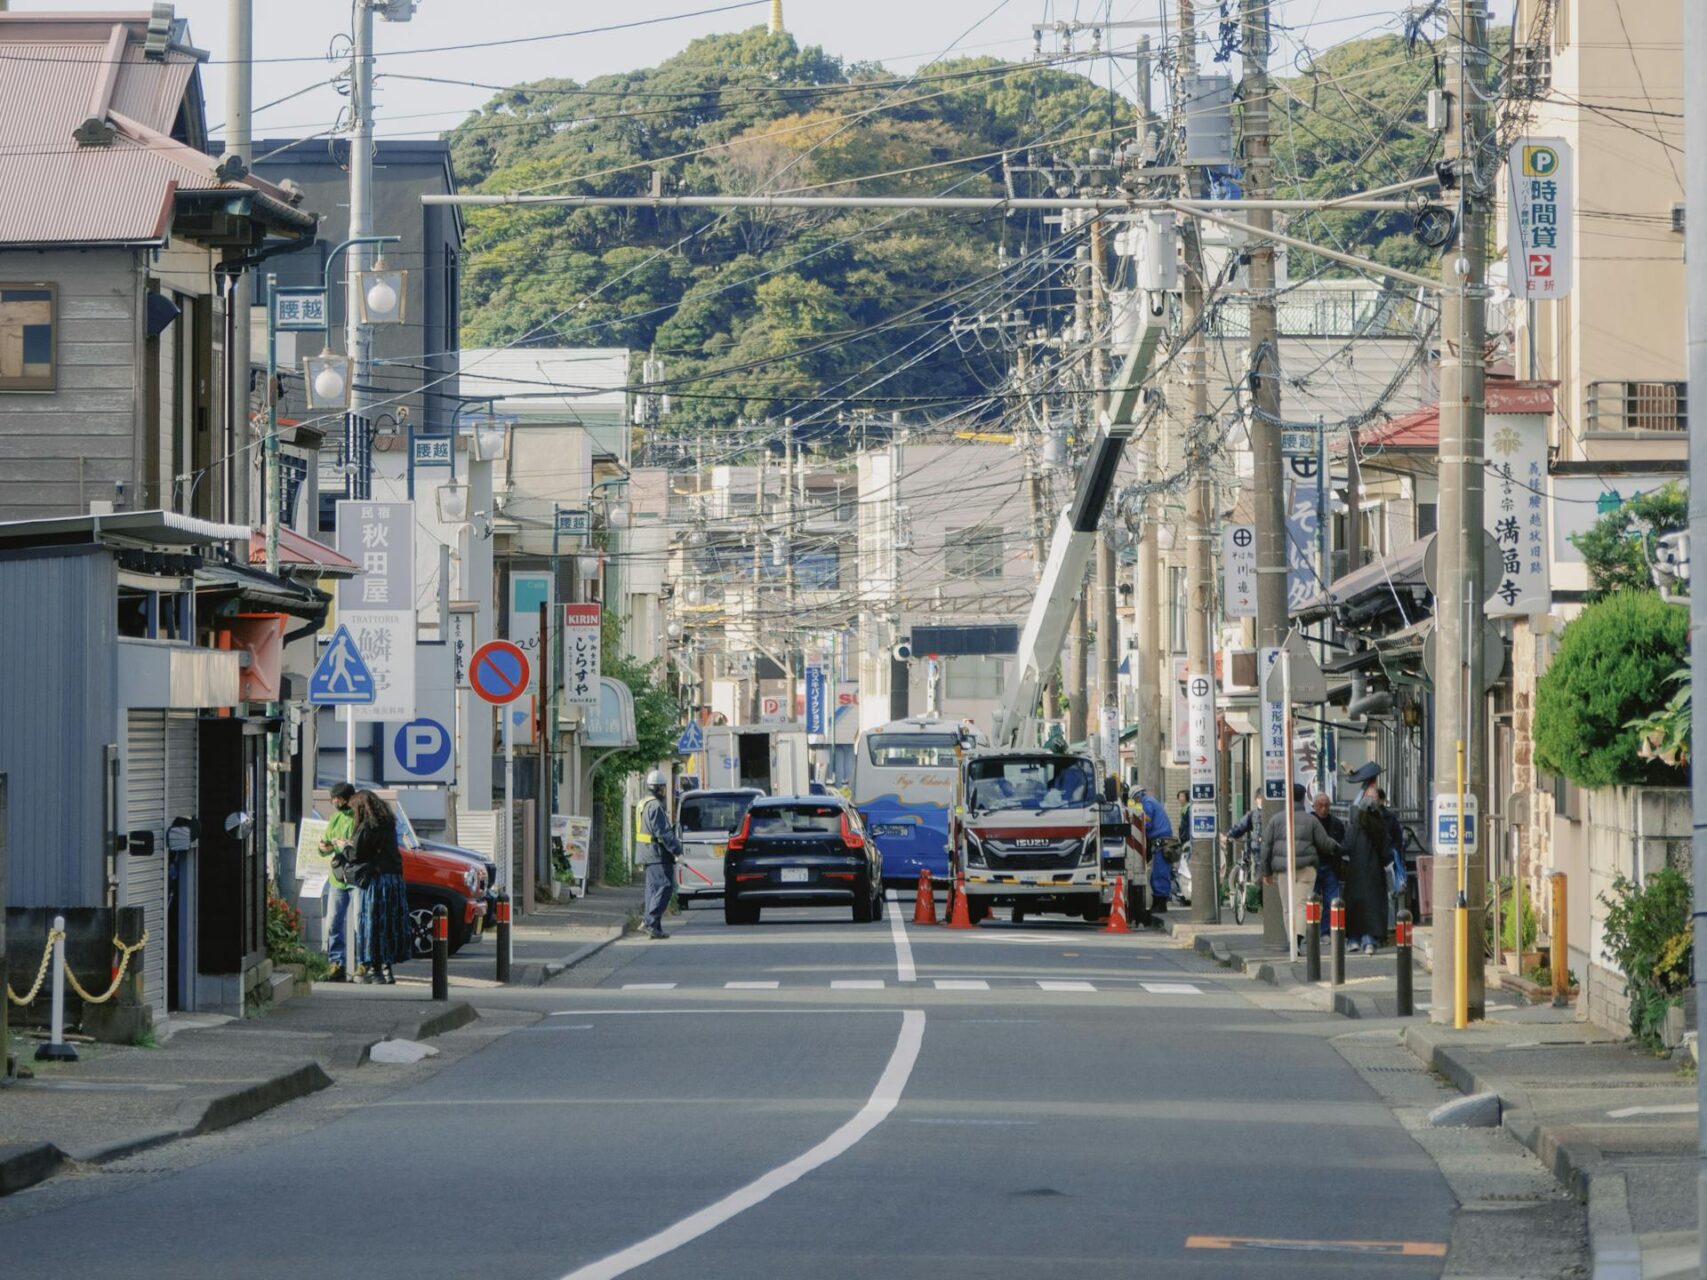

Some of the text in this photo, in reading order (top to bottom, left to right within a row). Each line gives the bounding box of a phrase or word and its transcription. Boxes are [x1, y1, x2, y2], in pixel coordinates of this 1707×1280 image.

[1531, 180, 1557, 249] 時間貸
[1526, 279, 1555, 291] 右折
[279, 299, 322, 320] 腰越
[416, 442, 449, 458] 腰越
[1282, 433, 1313, 450] 腰越
[1501, 462, 1515, 513] 真言宗
[361, 506, 391, 520] 民宿
[362, 522, 389, 604] 秋田屋
[1494, 515, 1523, 608] 満福寺
[352, 616, 399, 624] TRATTORIA
[568, 615, 598, 624] KIRIN
[575, 637, 588, 696] しらすや
[406, 726, 441, 768] P
[1015, 838, 1049, 847] ISUZU
